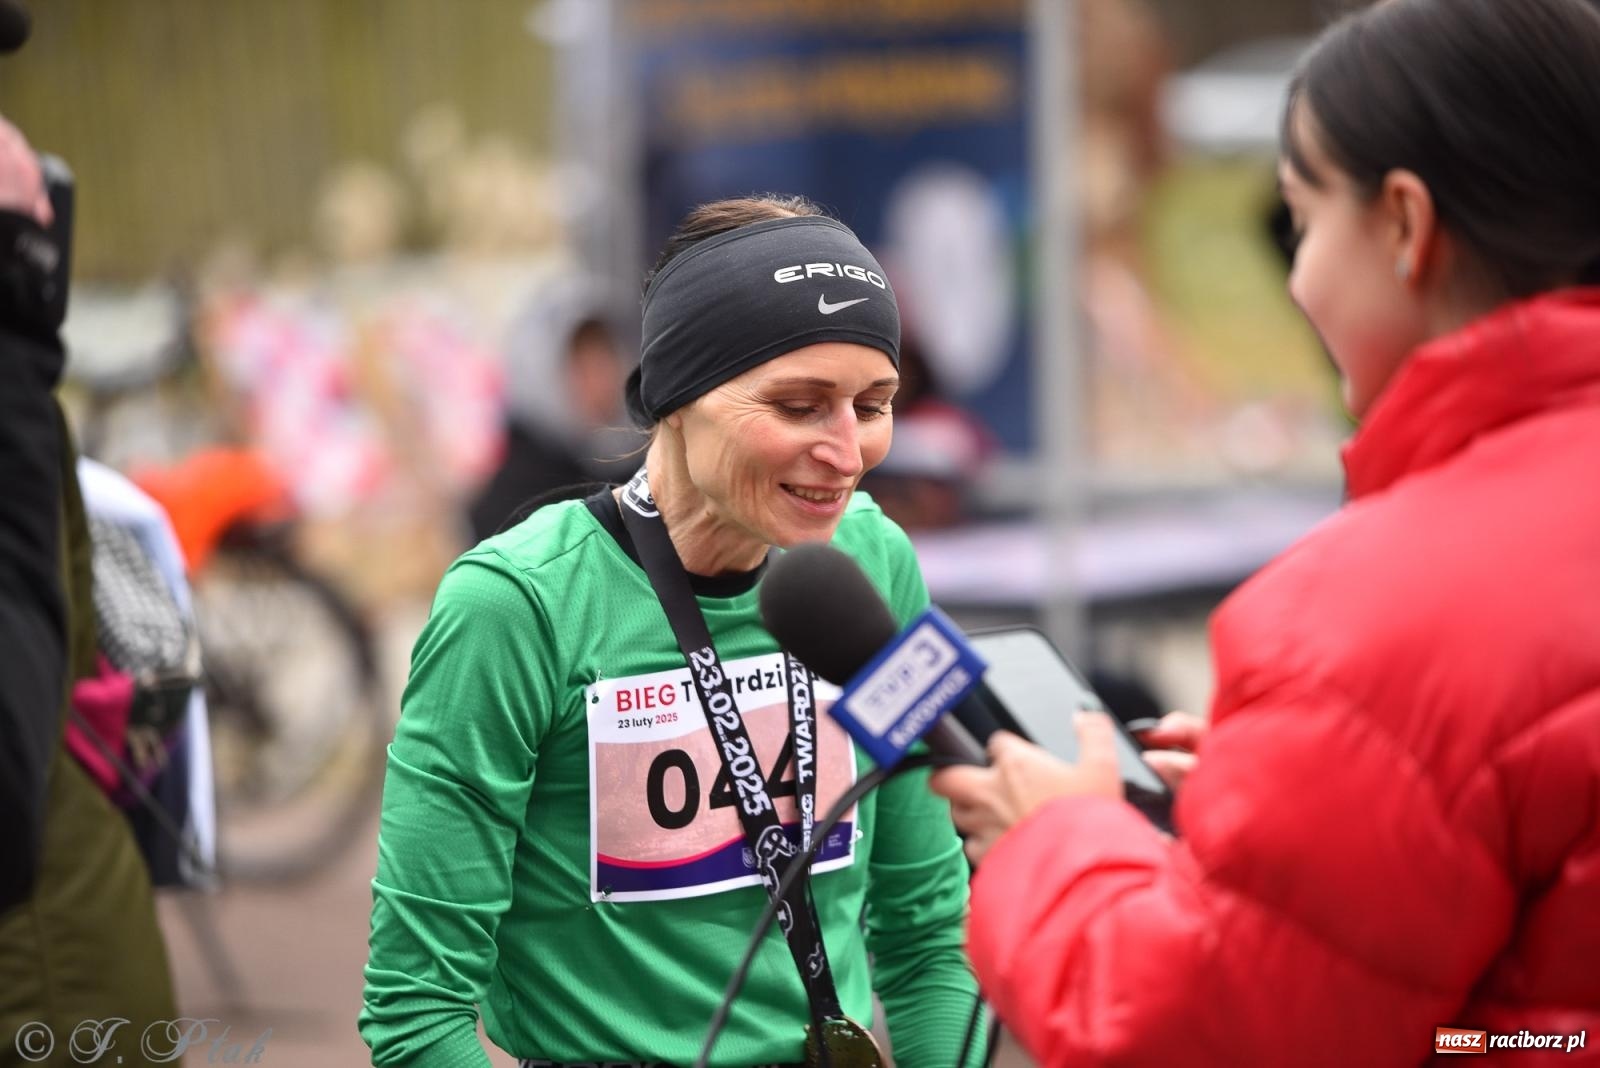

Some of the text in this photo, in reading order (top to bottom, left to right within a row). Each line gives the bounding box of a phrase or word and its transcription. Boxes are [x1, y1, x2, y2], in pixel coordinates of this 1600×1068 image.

[774, 262, 886, 290] ERIGO
[616, 683, 676, 712] BIEG
[618, 713, 678, 729] 23 luty 2025
[689, 646, 771, 816] 23.02.2025
